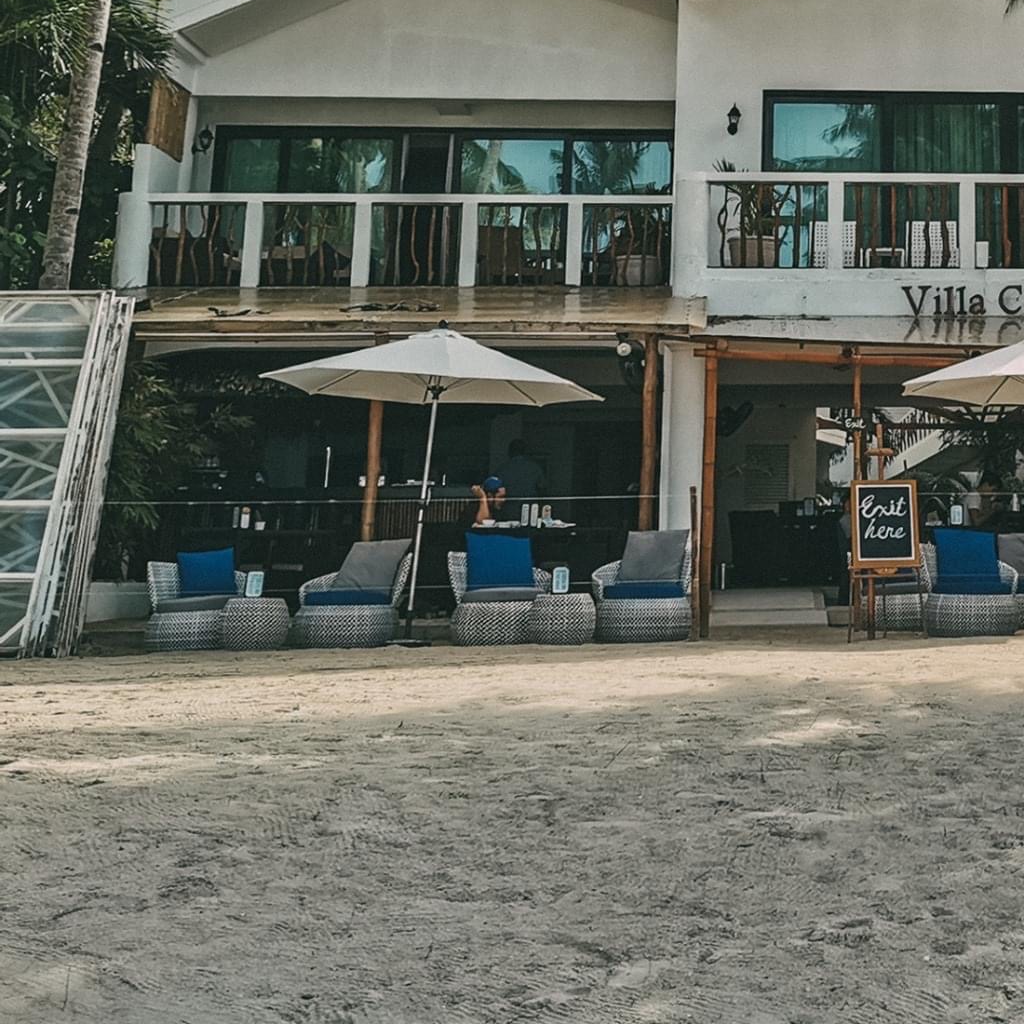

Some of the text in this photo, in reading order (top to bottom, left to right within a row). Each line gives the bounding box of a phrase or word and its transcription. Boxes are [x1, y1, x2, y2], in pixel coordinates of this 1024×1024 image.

[902, 285, 986, 316] Villa
[845, 418, 866, 429] Exit
[859, 494, 906, 518] Exit
[865, 517, 907, 539] here
